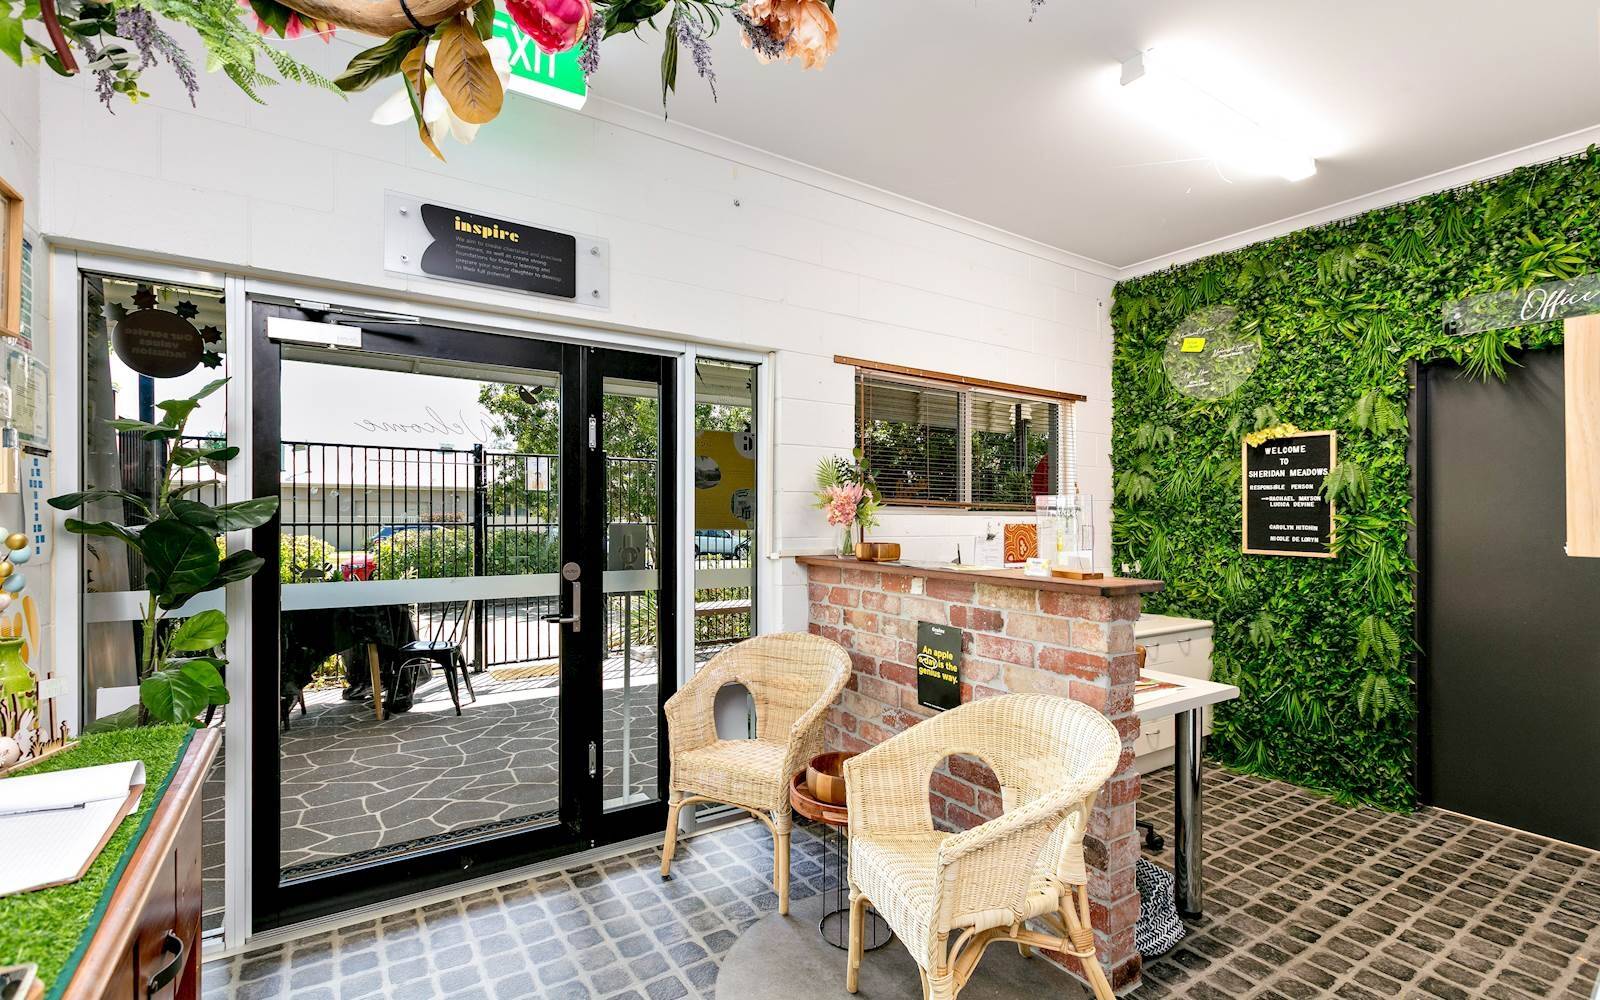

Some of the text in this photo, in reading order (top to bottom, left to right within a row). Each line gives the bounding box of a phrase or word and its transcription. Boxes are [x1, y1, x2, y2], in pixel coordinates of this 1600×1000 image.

[493, 19, 559, 79] XI
[454, 215, 520, 243] inspire
[456, 258, 478, 266] prepare
[510, 268, 534, 276] daughter
[519, 262, 540, 272] learning
[530, 258, 547, 266] strong
[1520, 281, 1600, 321] Office
[1264, 445, 1307, 455] WELCOME
[1279, 458, 1290, 466] TO
[1248, 468, 1328, 478] SHERIDAN MEADOWS
[922, 645, 954, 661] An apple
[925, 658, 936, 668] day
[938, 660, 944, 669] is
[945, 662, 958, 672] the
[918, 666, 958, 685] genius way.
